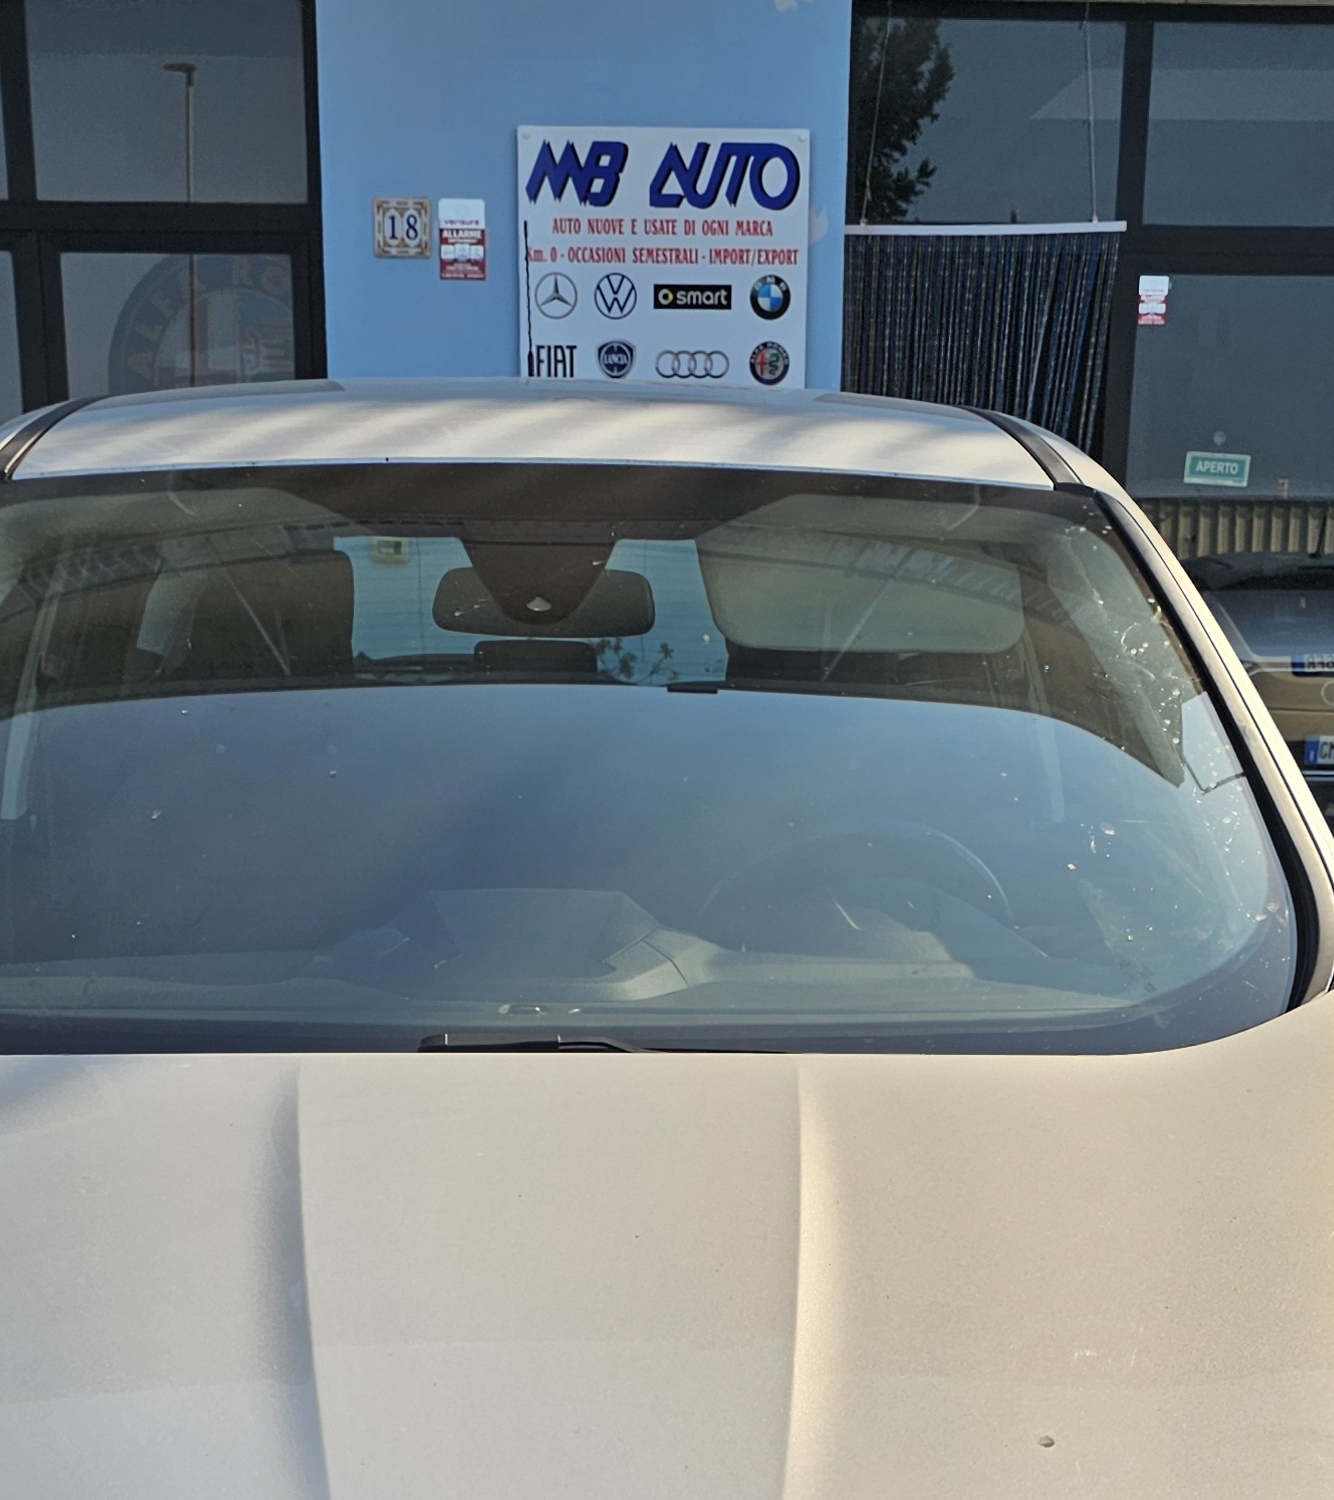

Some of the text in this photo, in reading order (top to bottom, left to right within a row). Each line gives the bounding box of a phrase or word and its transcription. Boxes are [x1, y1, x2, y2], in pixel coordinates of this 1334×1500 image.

[525, 138, 800, 210] MB AUTO
[389, 214, 418, 241] 18
[552, 218, 773, 236] AUTO NUOVE E USATE DI OGNI MARCA
[550, 246, 558, 262] 0
[568, 246, 626, 263] OCCASIONI
[632, 247, 698, 265] SEMESTRALI
[710, 248, 799, 267] IMPORT/EXPORT
[676, 288, 728, 306] smart
[535, 345, 578, 378] FIAT
[1195, 460, 1239, 475] APERTO
